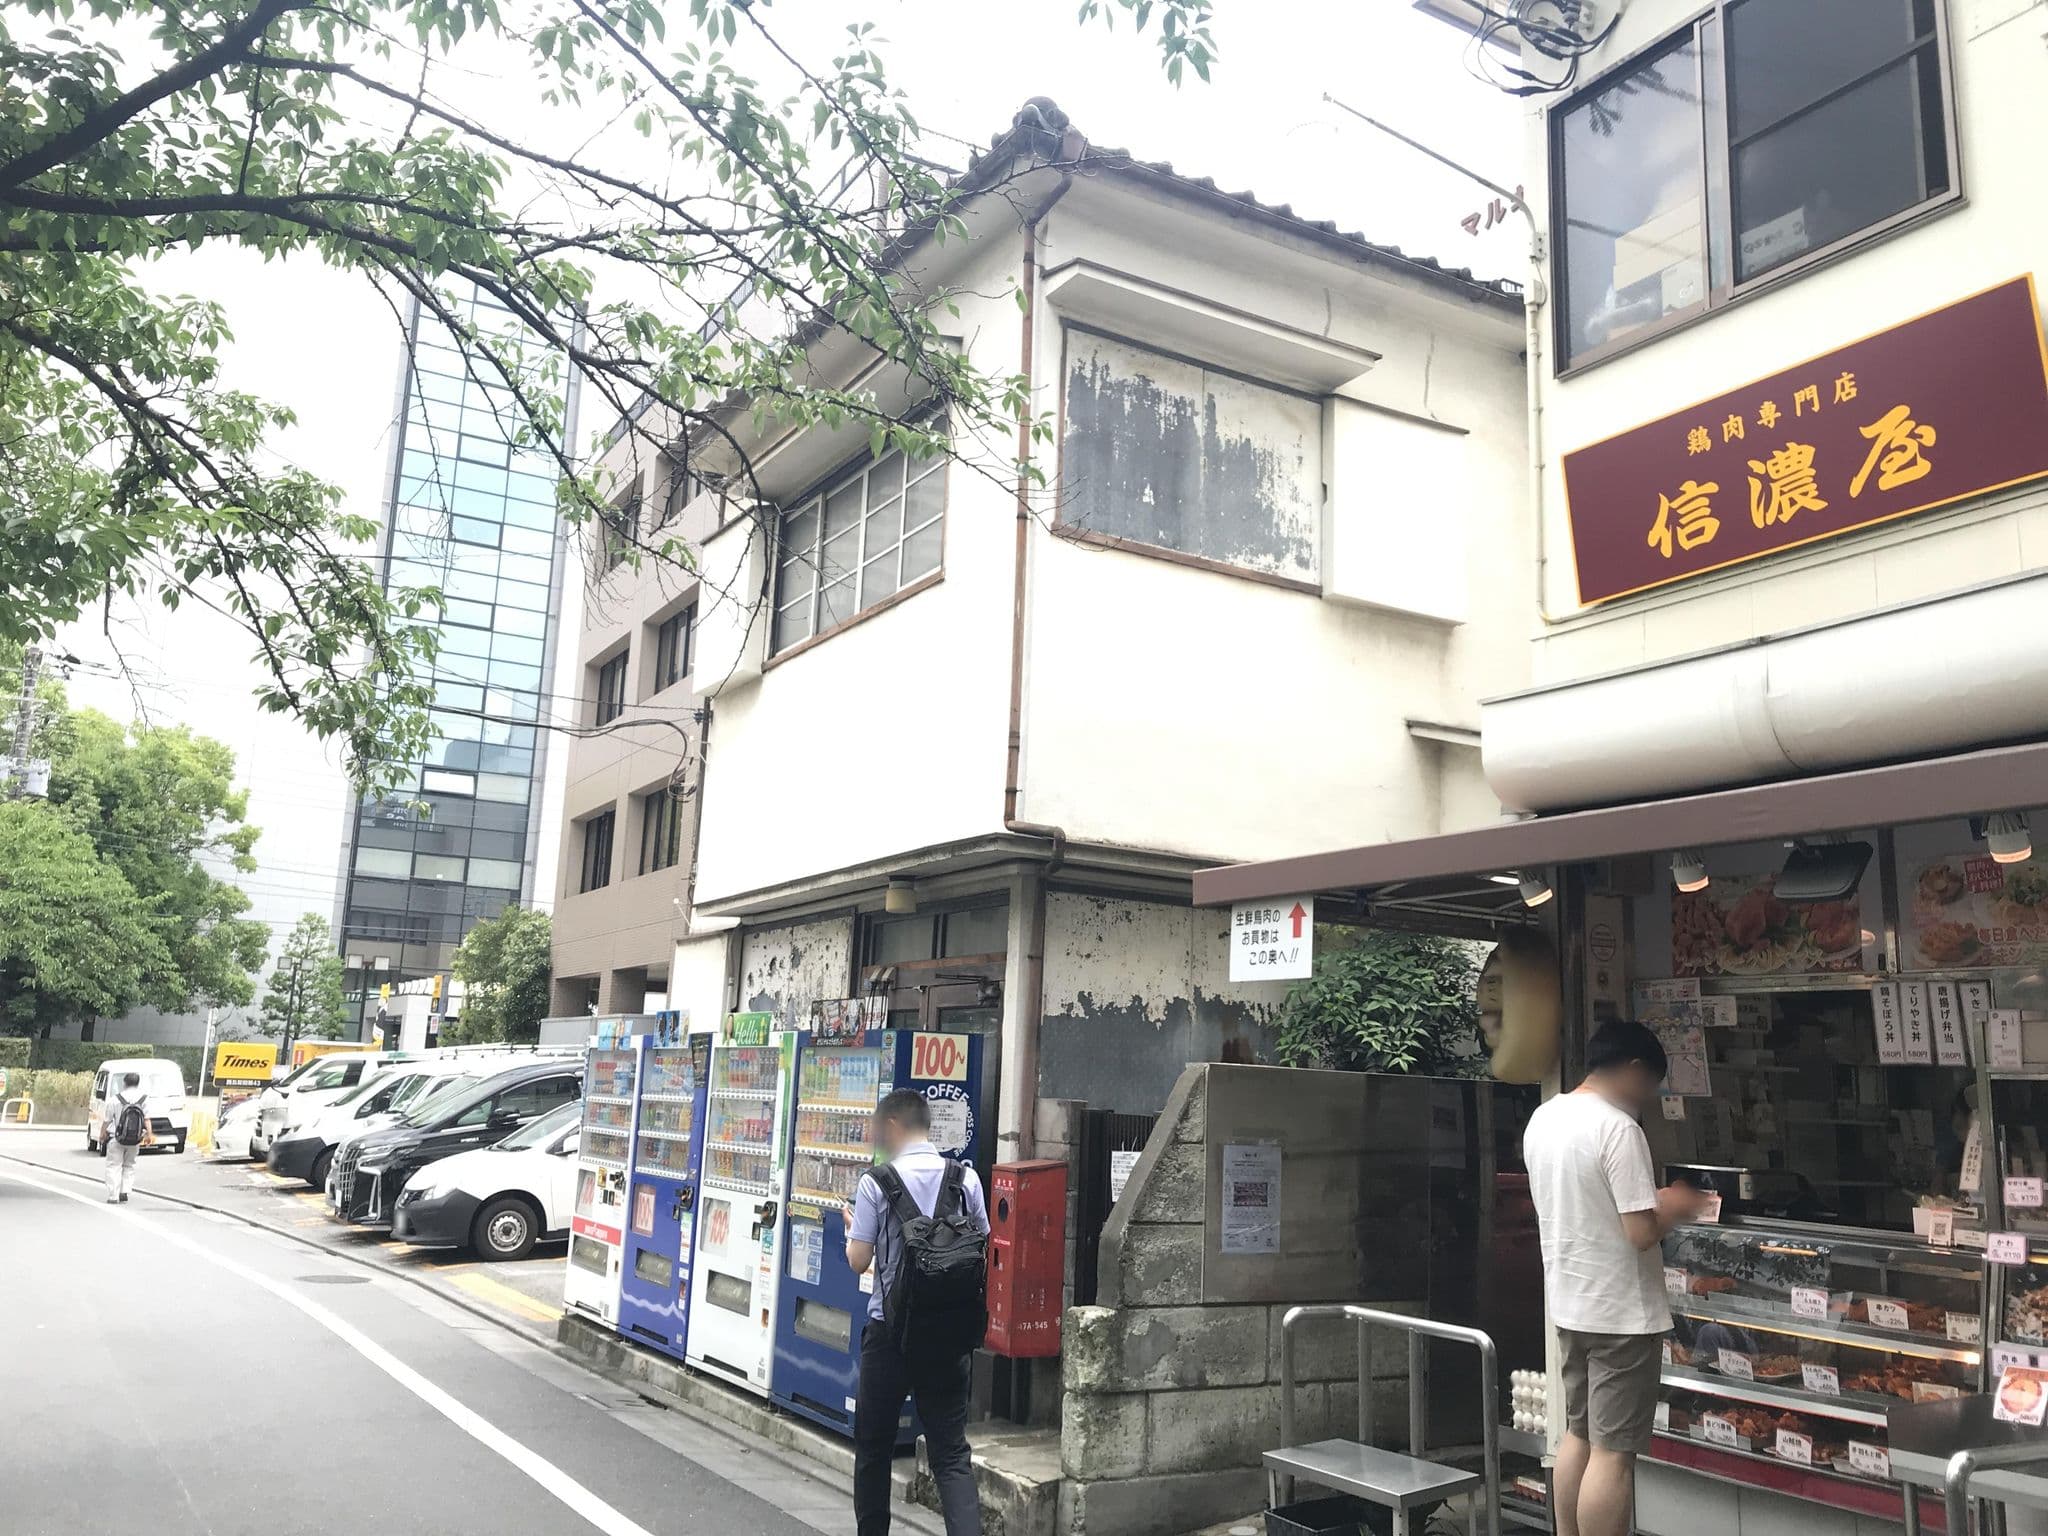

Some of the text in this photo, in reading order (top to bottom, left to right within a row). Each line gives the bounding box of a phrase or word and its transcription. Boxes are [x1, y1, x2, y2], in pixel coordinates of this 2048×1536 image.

[1687, 371, 1858, 456] 鶏肉専門店
[1647, 404, 1936, 558] 信濃屋
[1242, 929, 1279, 945] お買物は
[734, 1021, 758, 1044] Hello.
[1880, 986, 1895, 1043] 鶏そぼろ丼
[1908, 985, 1921, 1042] てりやき丼
[1938, 986, 1954, 1044] 唐揚げ弁当
[223, 1055, 270, 1068] Times
[920, 1083, 969, 1102] OFFEE
[1875, 1303, 1896, 1313] 串カツ
